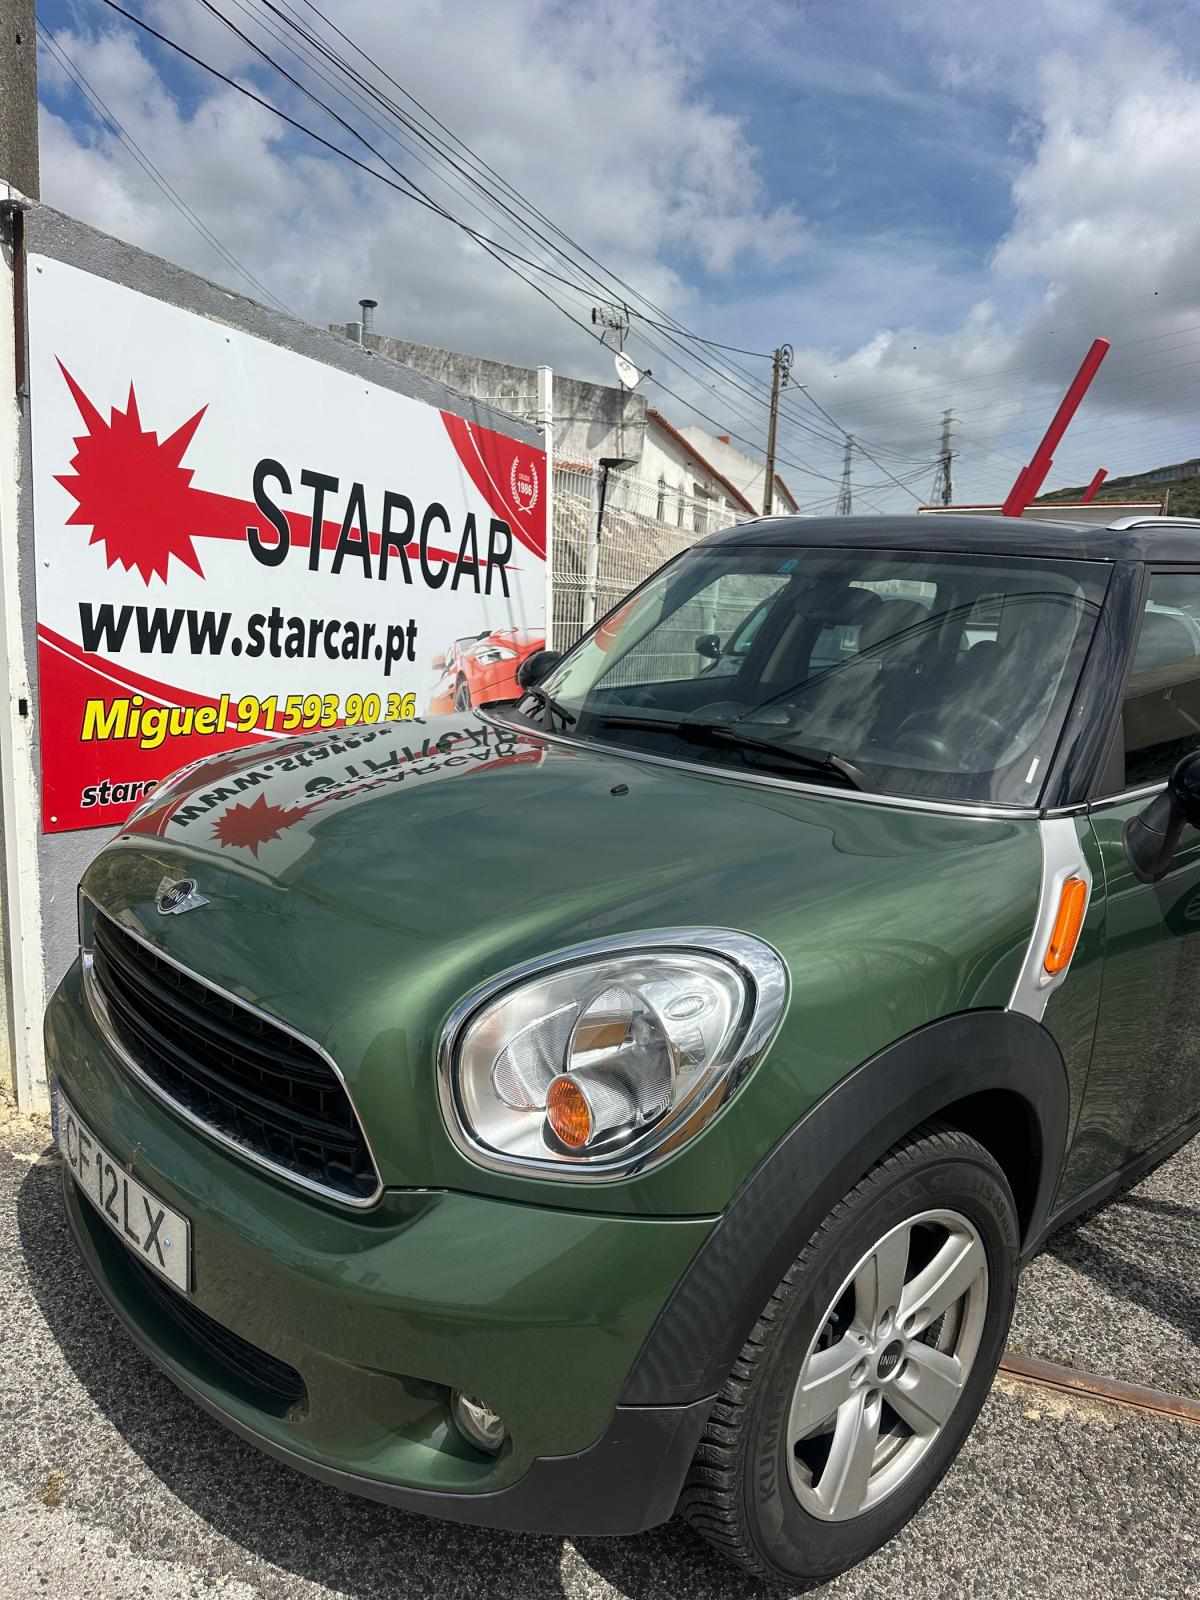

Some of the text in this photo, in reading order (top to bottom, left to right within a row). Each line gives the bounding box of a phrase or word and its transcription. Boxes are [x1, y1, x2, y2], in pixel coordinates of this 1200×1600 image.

[247, 458, 512, 598] STARCAR
[78, 602, 418, 677] www.starcar.pt
[80, 692, 417, 749] Miguel 91 593 90 36
